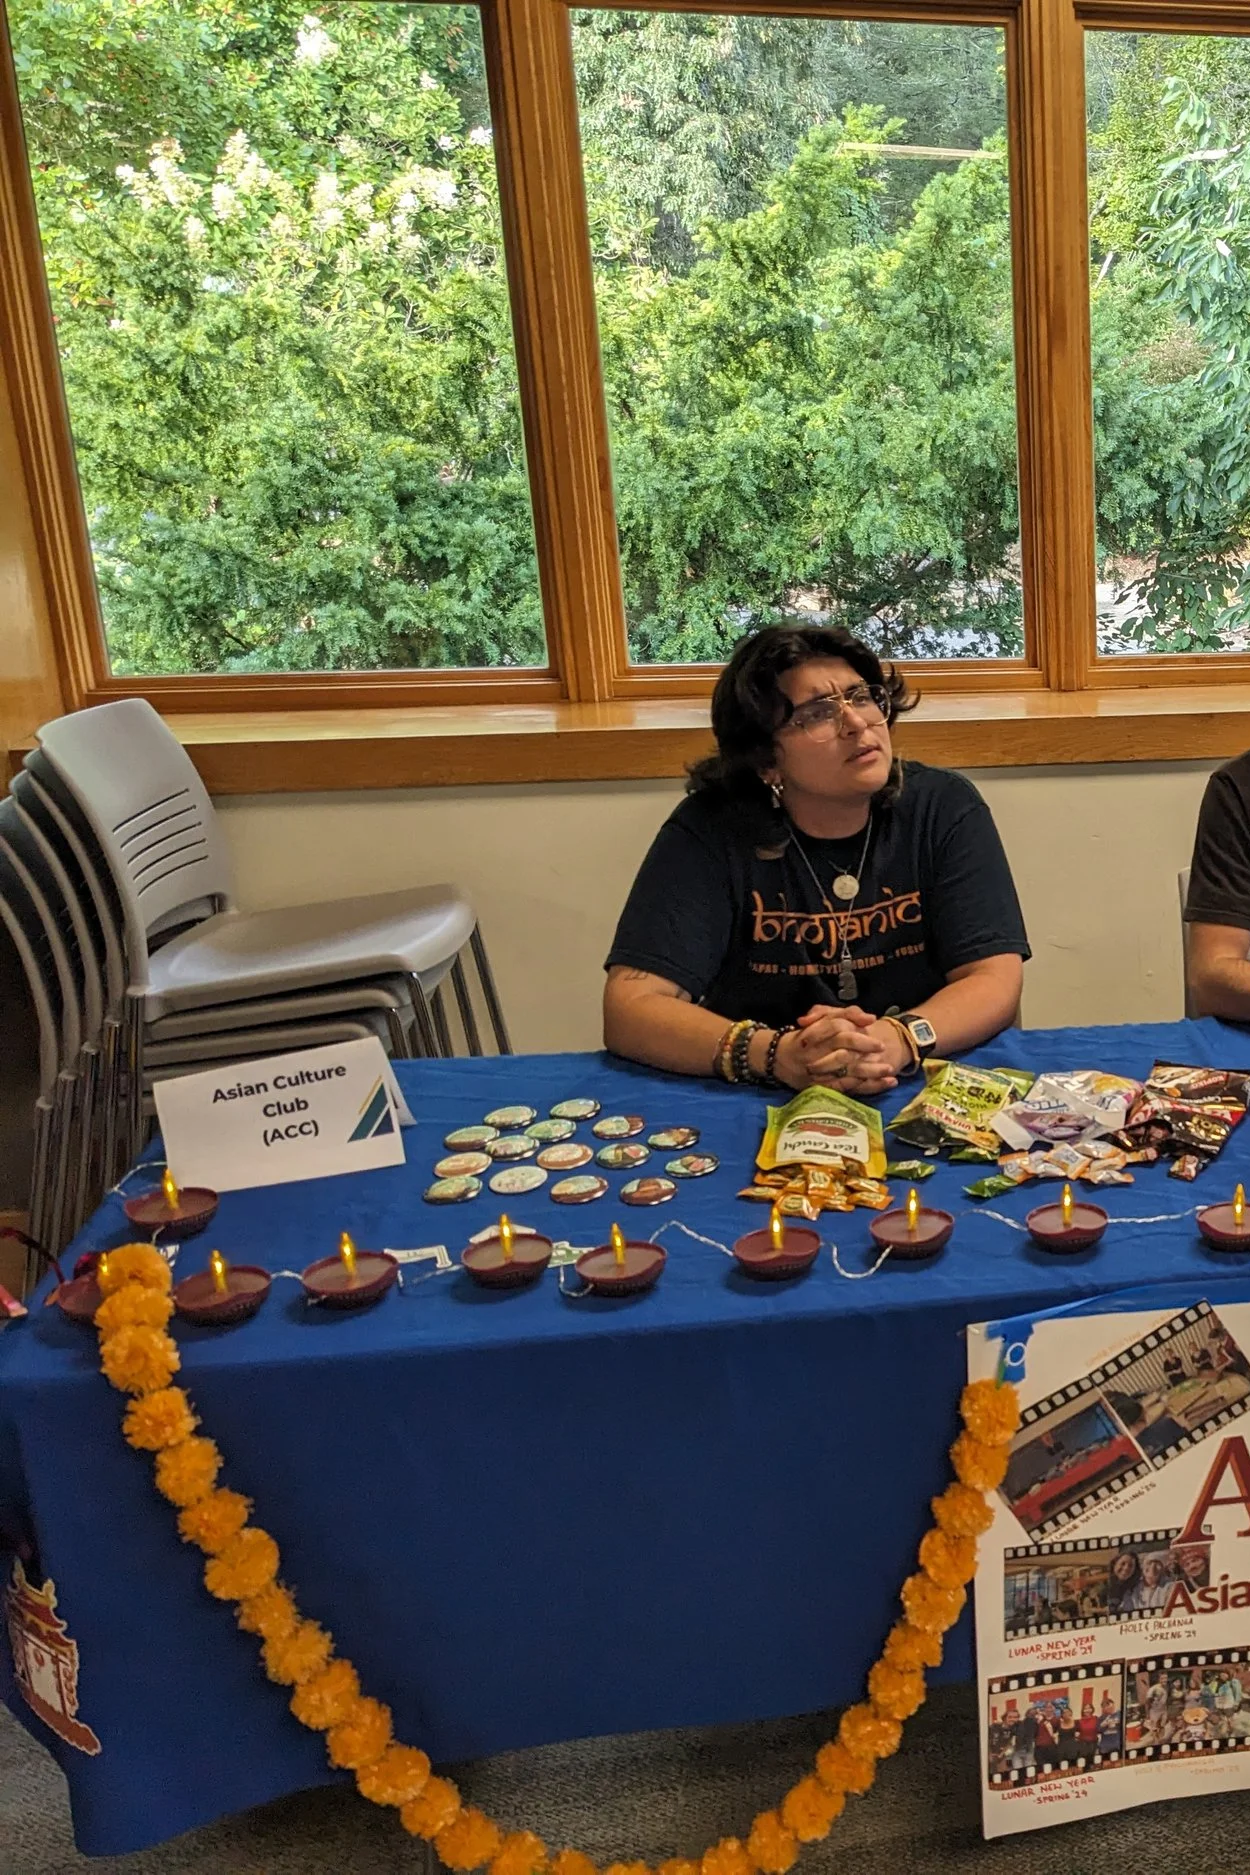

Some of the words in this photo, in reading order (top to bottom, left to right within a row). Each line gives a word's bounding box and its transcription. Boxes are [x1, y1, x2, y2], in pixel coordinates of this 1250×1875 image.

[212, 1082, 269, 1104] Asian
[272, 1065, 347, 1091] Culture
[262, 1097, 309, 1118] Club
[262, 1119, 320, 1147] (ACC)
[1007, 1643, 1043, 1659] LUNAR
[1046, 1638, 1072, 1651] NEW
[1072, 1634, 1098, 1648] YEAR
[1001, 1787, 1036, 1801] LUNAR
[1039, 1782, 1063, 1794] NEW
[1066, 1775, 1096, 1789] YEAR
